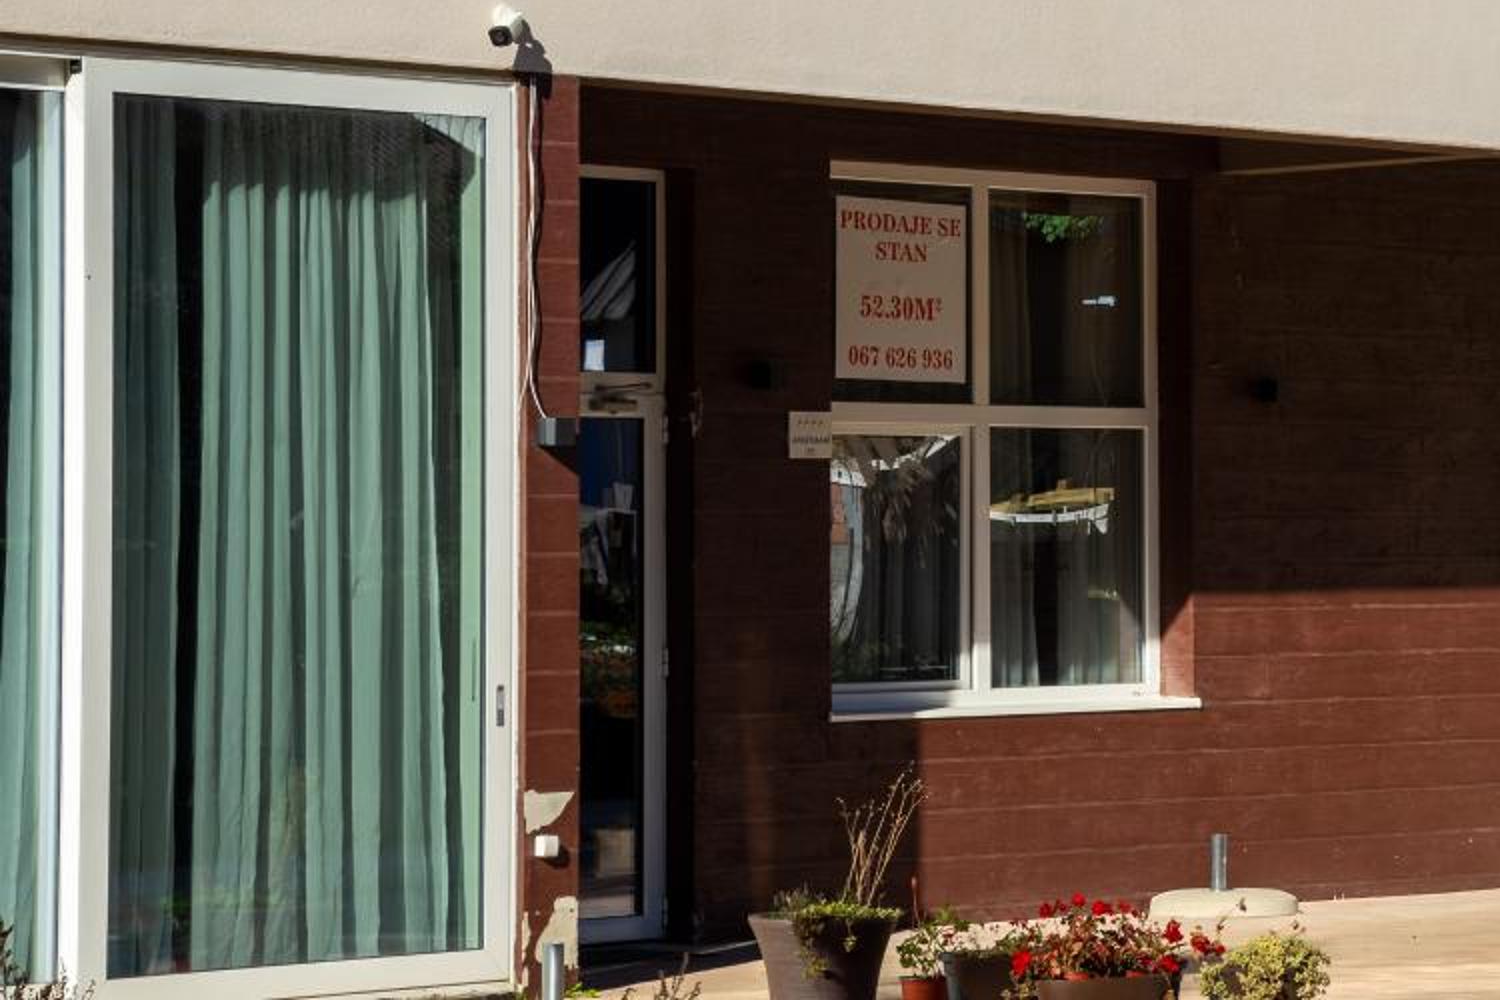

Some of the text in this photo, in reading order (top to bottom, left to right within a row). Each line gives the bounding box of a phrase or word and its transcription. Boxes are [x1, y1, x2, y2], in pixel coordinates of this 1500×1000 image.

[840, 209, 961, 238] PRODAJE SE
[875, 241, 928, 263] STAN
[848, 345, 953, 370] 067 626 936
